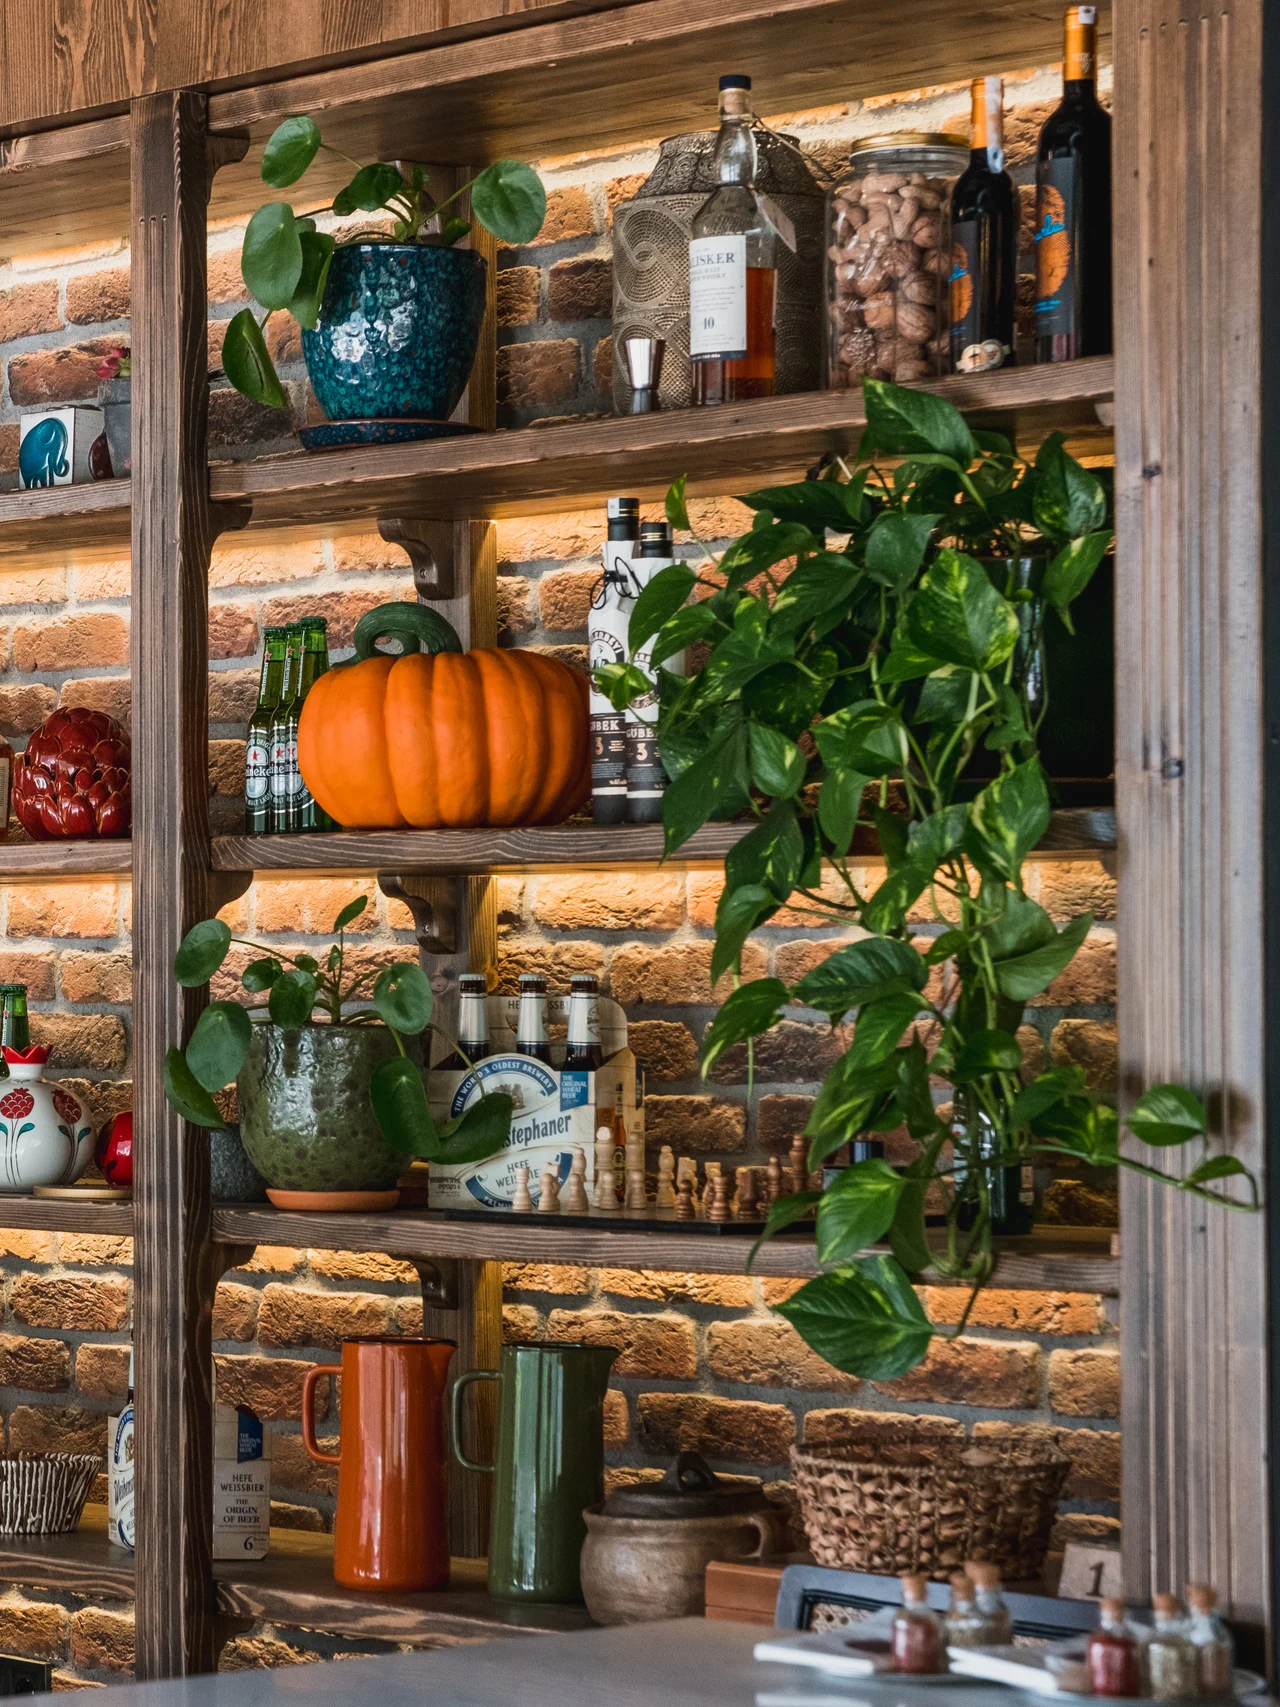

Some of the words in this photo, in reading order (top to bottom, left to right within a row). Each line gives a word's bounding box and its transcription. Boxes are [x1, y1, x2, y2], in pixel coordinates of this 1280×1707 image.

[690, 252, 736, 268] LISKER
[703, 316, 715, 330] 10
[636, 742, 648, 761] 3
[455, 1096, 464, 1112] THE
[460, 1067, 490, 1094] WORD'S
[491, 1062, 521, 1071] OLDEST
[522, 1063, 554, 1089] BREWERY
[502, 1113, 572, 1149] stephaner
[232, 1473, 253, 1482] HEFE
[220, 1483, 265, 1492] WEISSBIER
[225, 1506, 258, 1514] ORIGIN
[223, 1515, 236, 1523] OF
[237, 1515, 260, 1523] BEER
[243, 1535, 254, 1551] 6
[1085, 1560, 1105, 1598] 1
